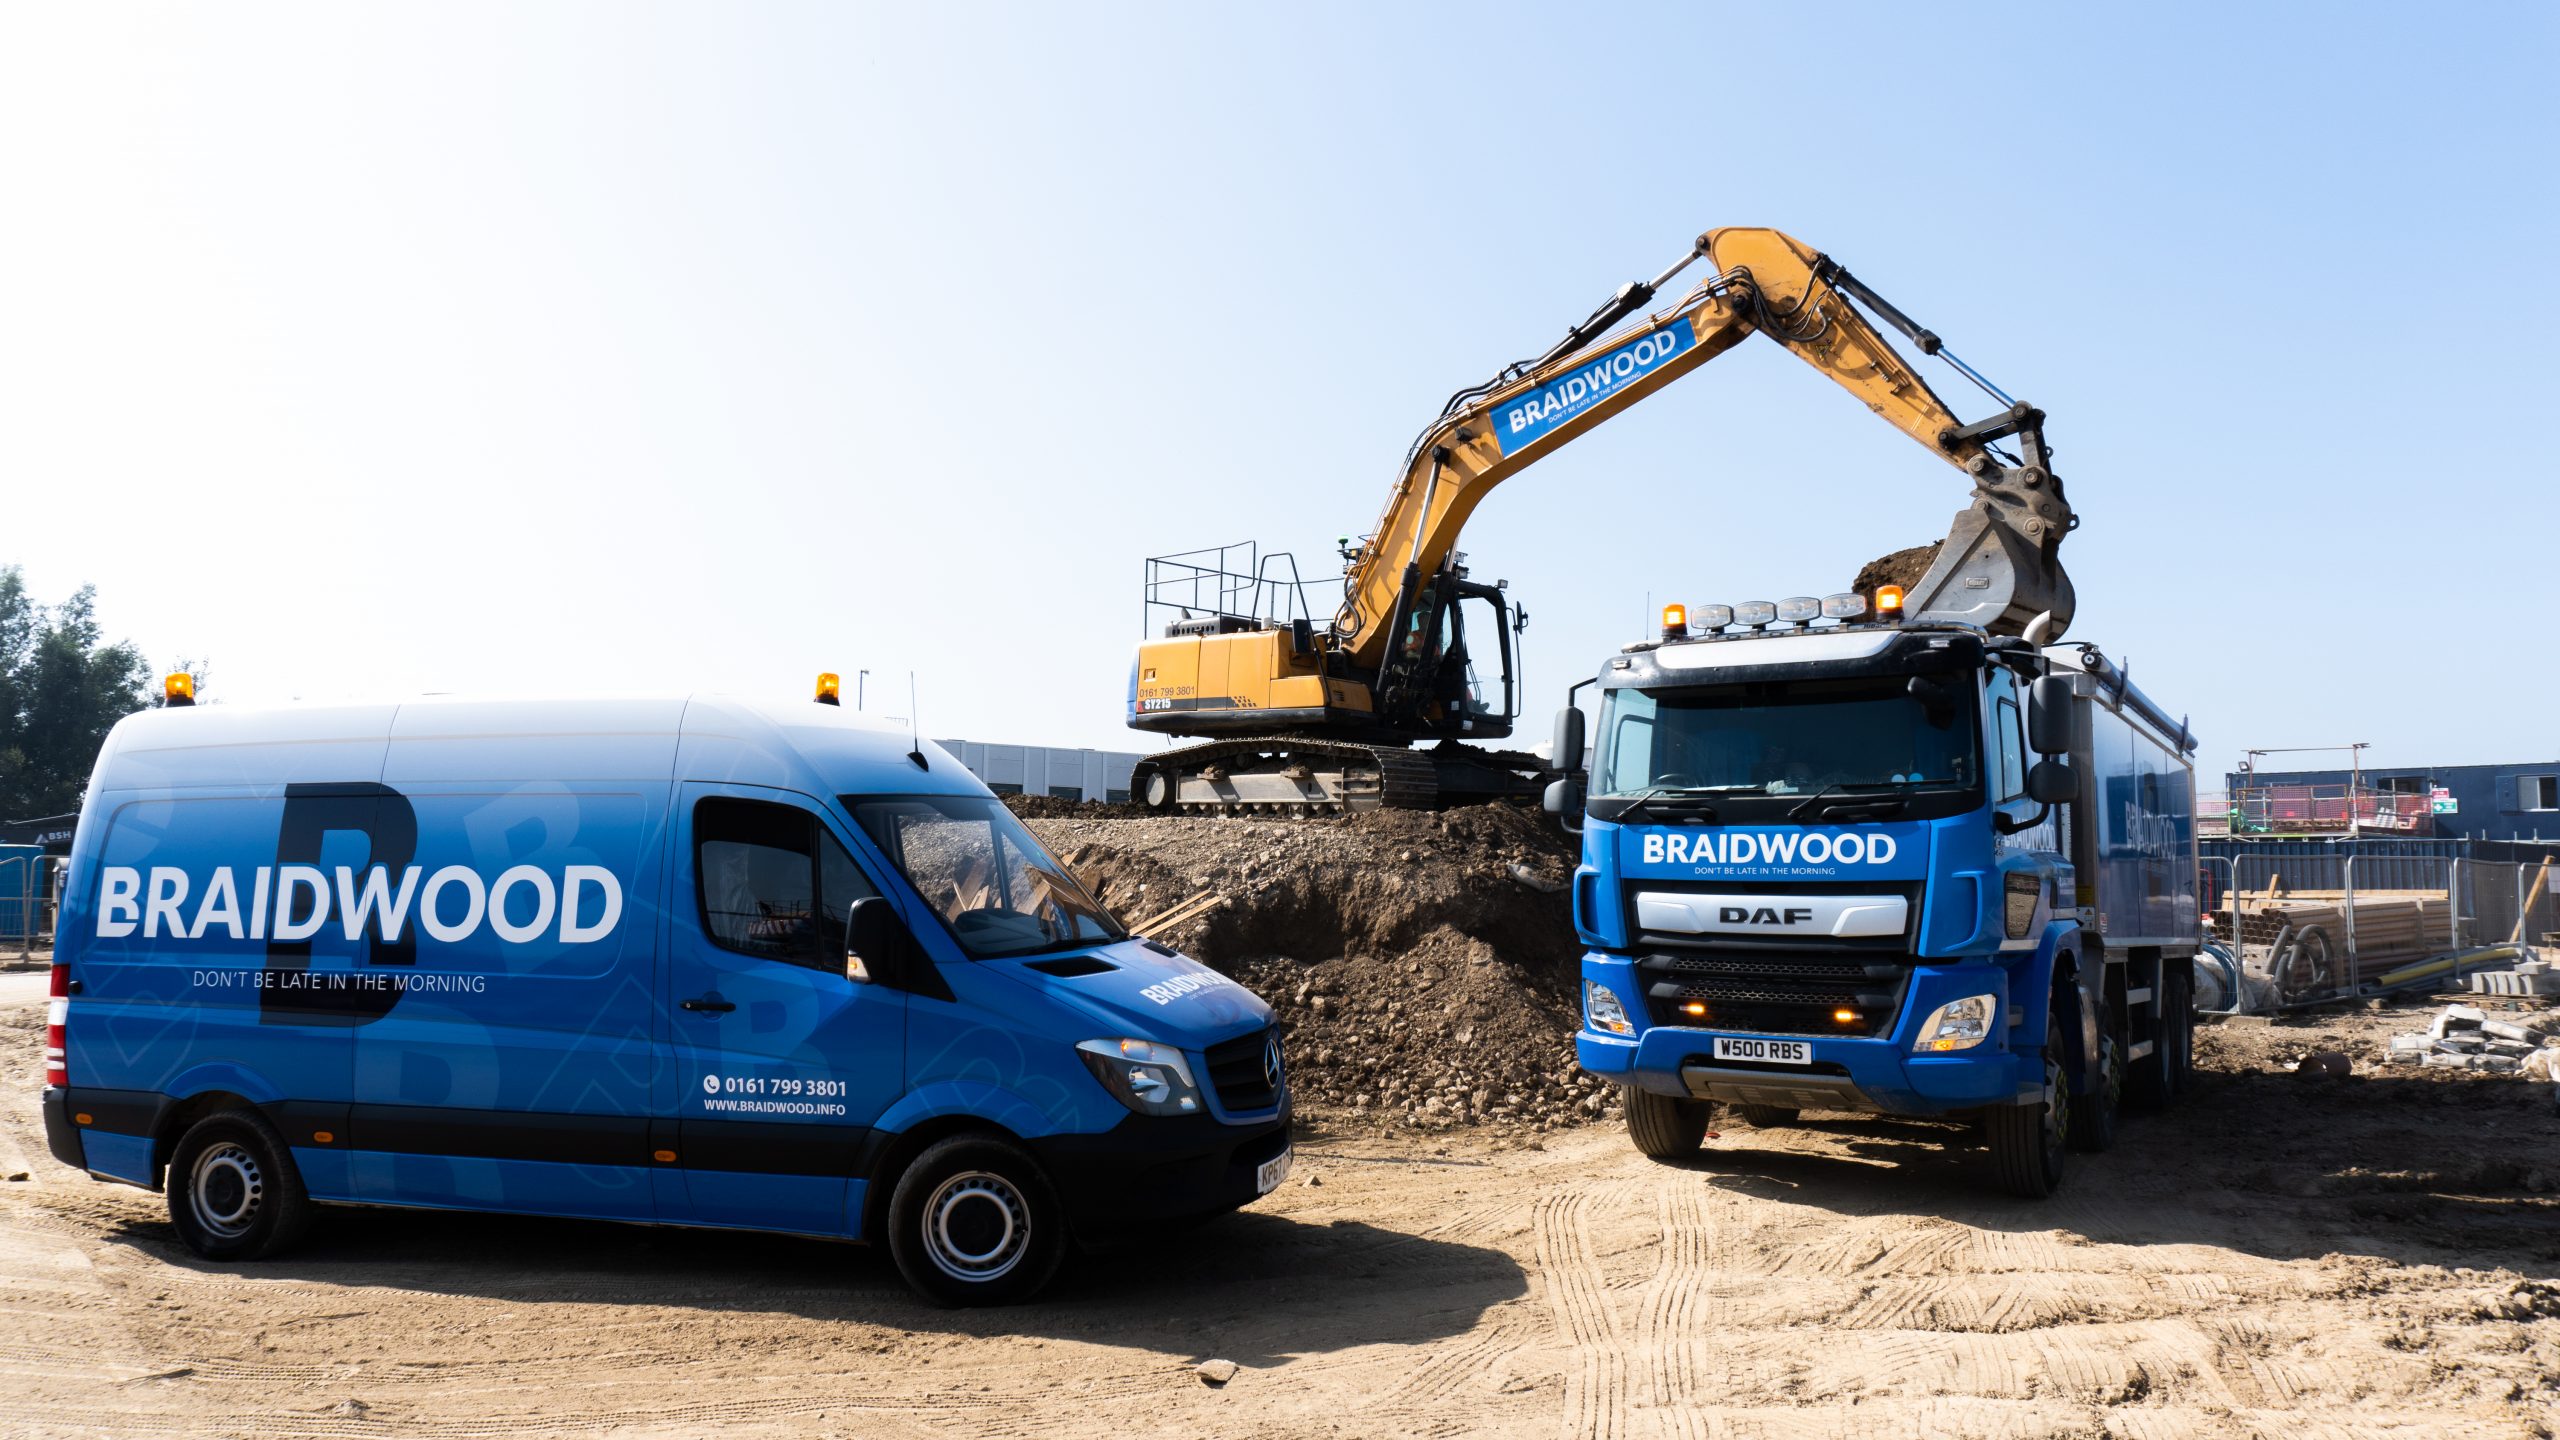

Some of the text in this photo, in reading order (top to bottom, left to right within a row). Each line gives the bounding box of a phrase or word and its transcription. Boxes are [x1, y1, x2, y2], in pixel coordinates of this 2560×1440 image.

[1508, 330, 1676, 434] BRAIDWOOD
[1548, 410, 1568, 424] DON'T
[1568, 406, 1576, 416] BE
[1576, 398, 1591, 413] LATE
[1599, 386, 1612, 398] THE
[1612, 371, 1642, 393] MORNING
[1140, 686, 1195, 698] 0161 799 3801
[1144, 698, 1171, 710] SY215
[48, 831, 72, 840] BSH
[2125, 800, 2177, 862] BRAIDWOOD
[1643, 832, 1897, 864] BRAIDWOOD
[1694, 867, 1836, 875] DON'T BE LATE IN THE MORNING
[97, 864, 623, 943] BRAIDWOOD
[1719, 907, 1812, 925] DAF
[193, 971, 485, 993] DON'T BE LATE IN THE MORNING
[1139, 971, 1234, 1006] BRAIDWO
[1721, 1039, 1803, 1060] W500 RBS
[725, 1077, 846, 1097] 0161 799 3801
[704, 1099, 846, 1116] WWW.BRAIDWOOD.INFO
